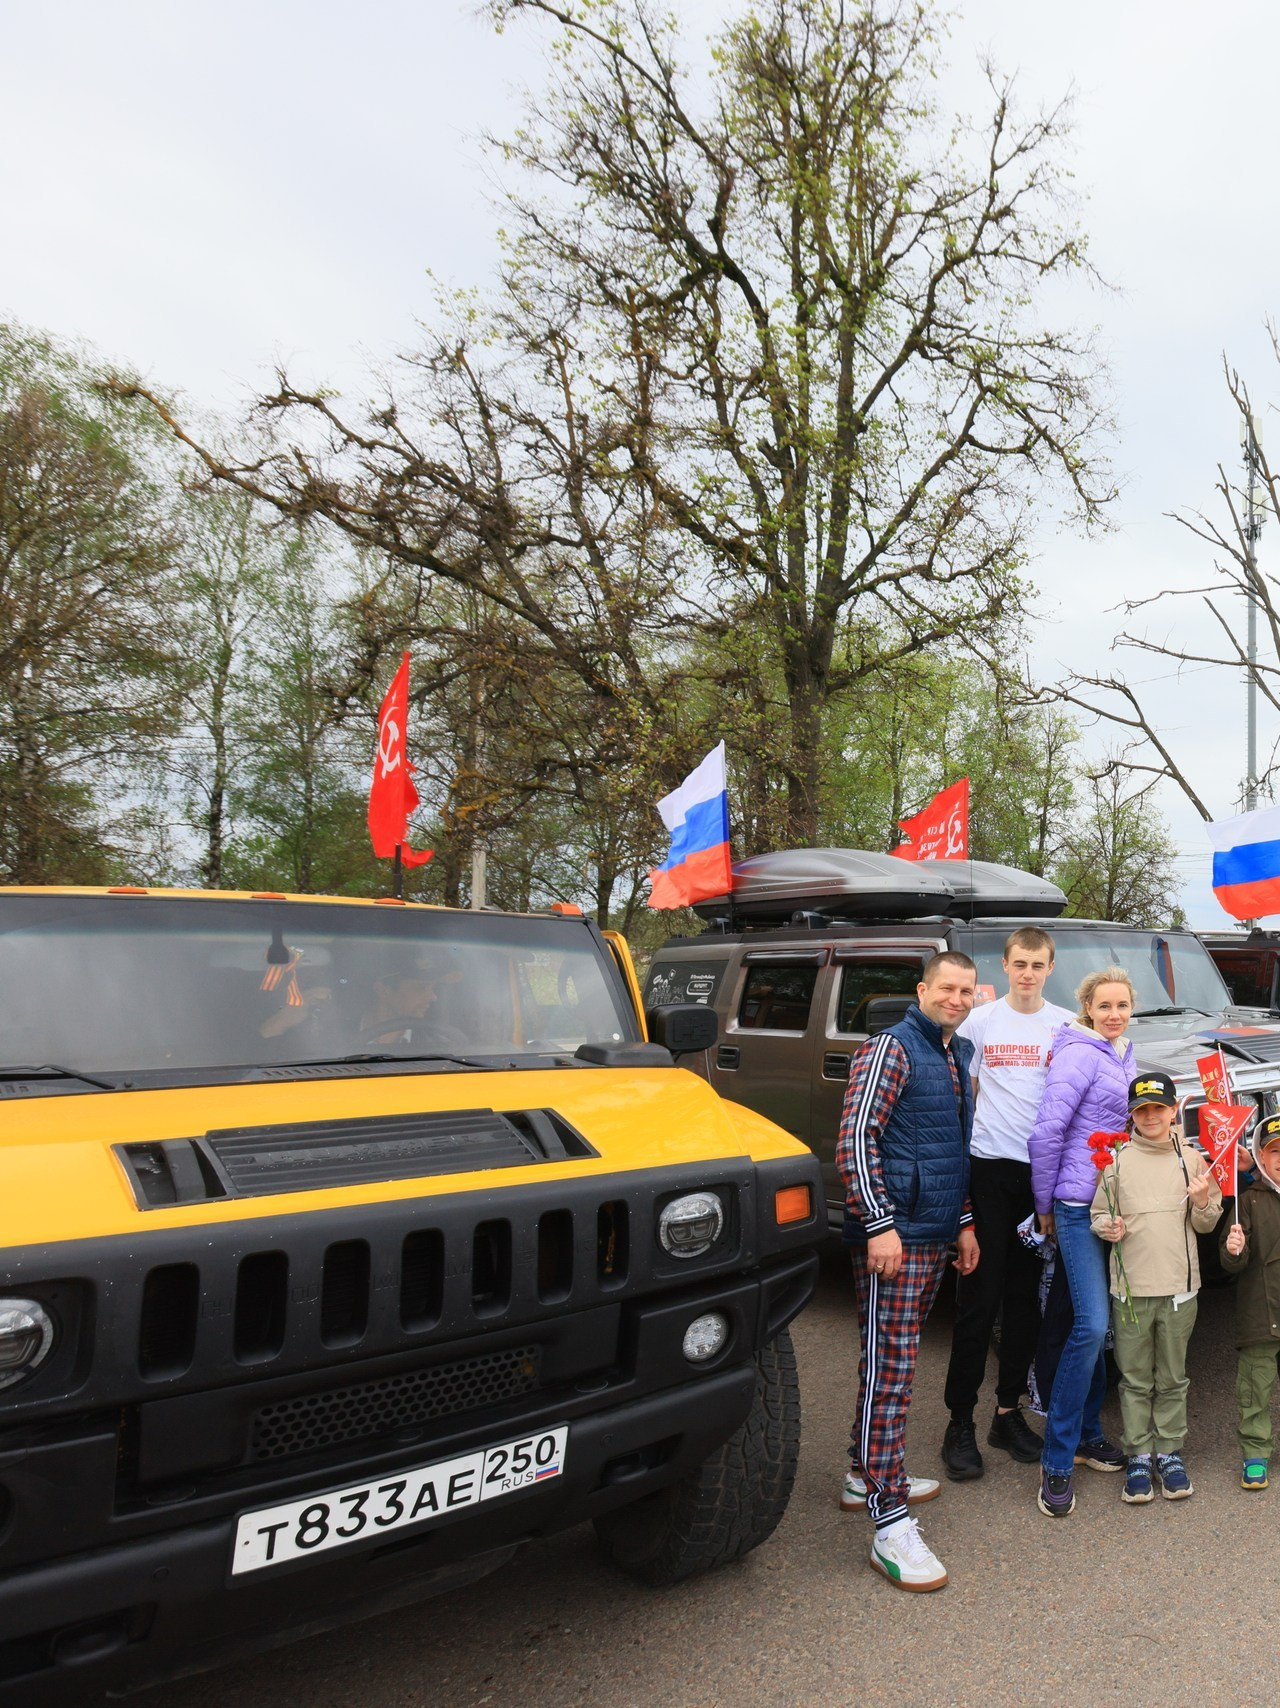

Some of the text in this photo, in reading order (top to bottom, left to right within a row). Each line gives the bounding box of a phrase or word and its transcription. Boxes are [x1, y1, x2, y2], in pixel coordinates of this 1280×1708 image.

[984, 1044, 1041, 1055] АВТОПРОБЕГ
[501, 1471, 534, 1491] RUS
[257, 1434, 557, 1560] Т833АЕ 250
